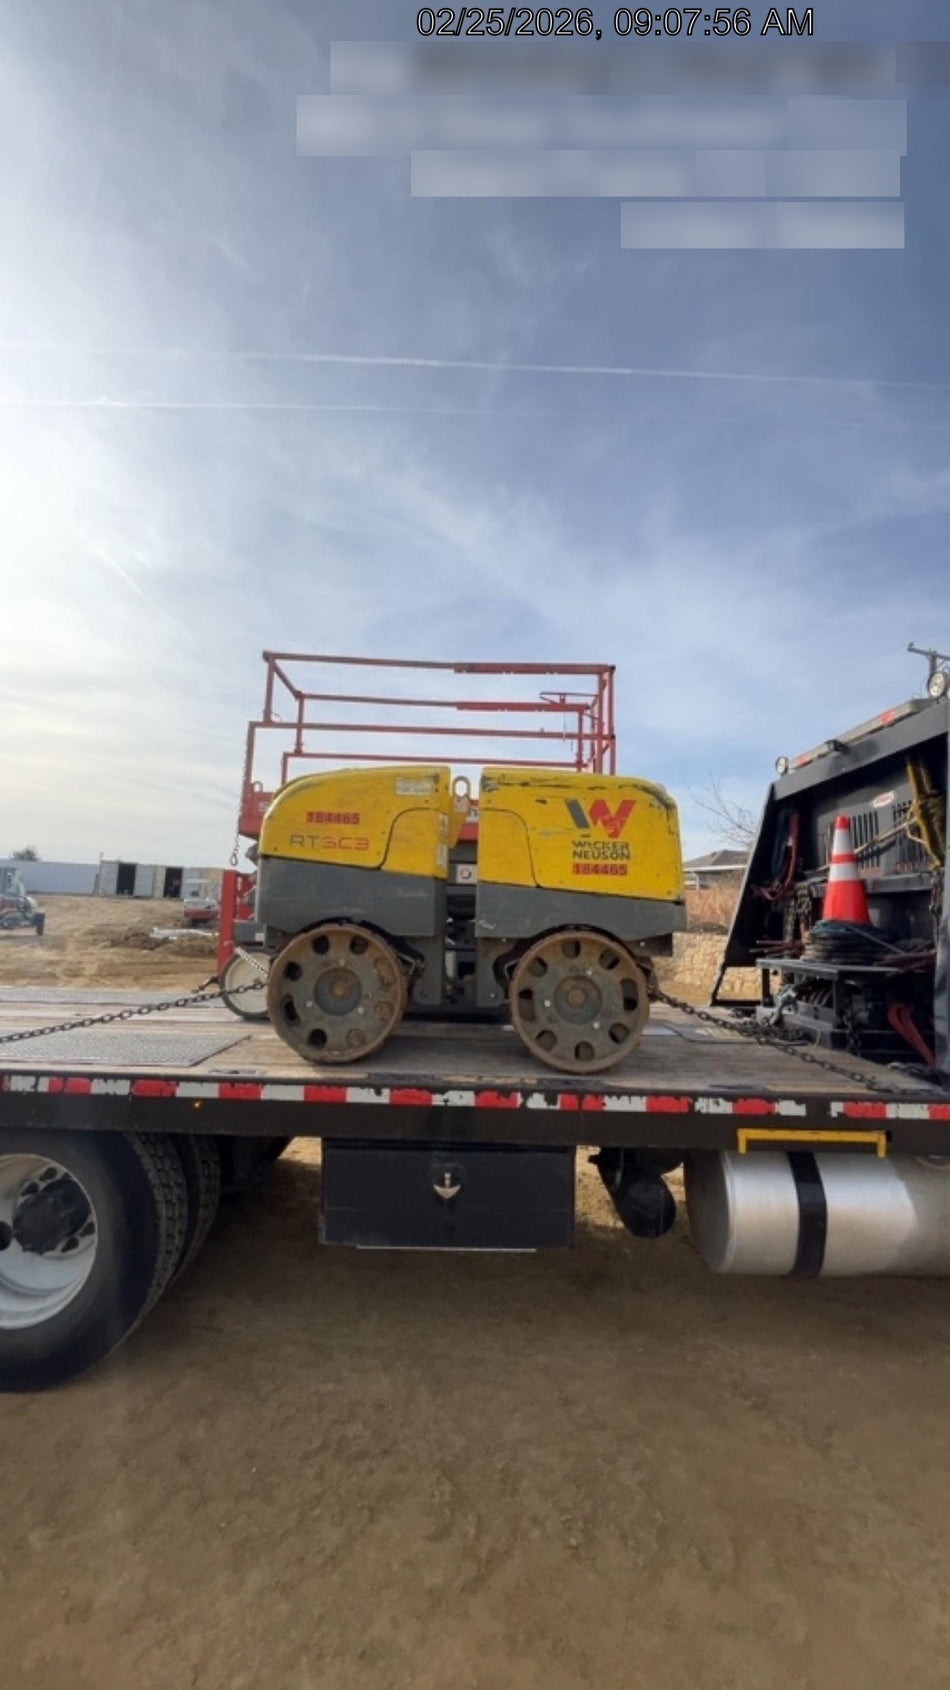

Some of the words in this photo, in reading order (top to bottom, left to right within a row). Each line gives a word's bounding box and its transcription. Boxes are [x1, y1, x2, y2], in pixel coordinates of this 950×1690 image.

[306, 811, 360, 825] 184465
[572, 849, 631, 861] NEUSON
[573, 863, 628, 876] 184465
